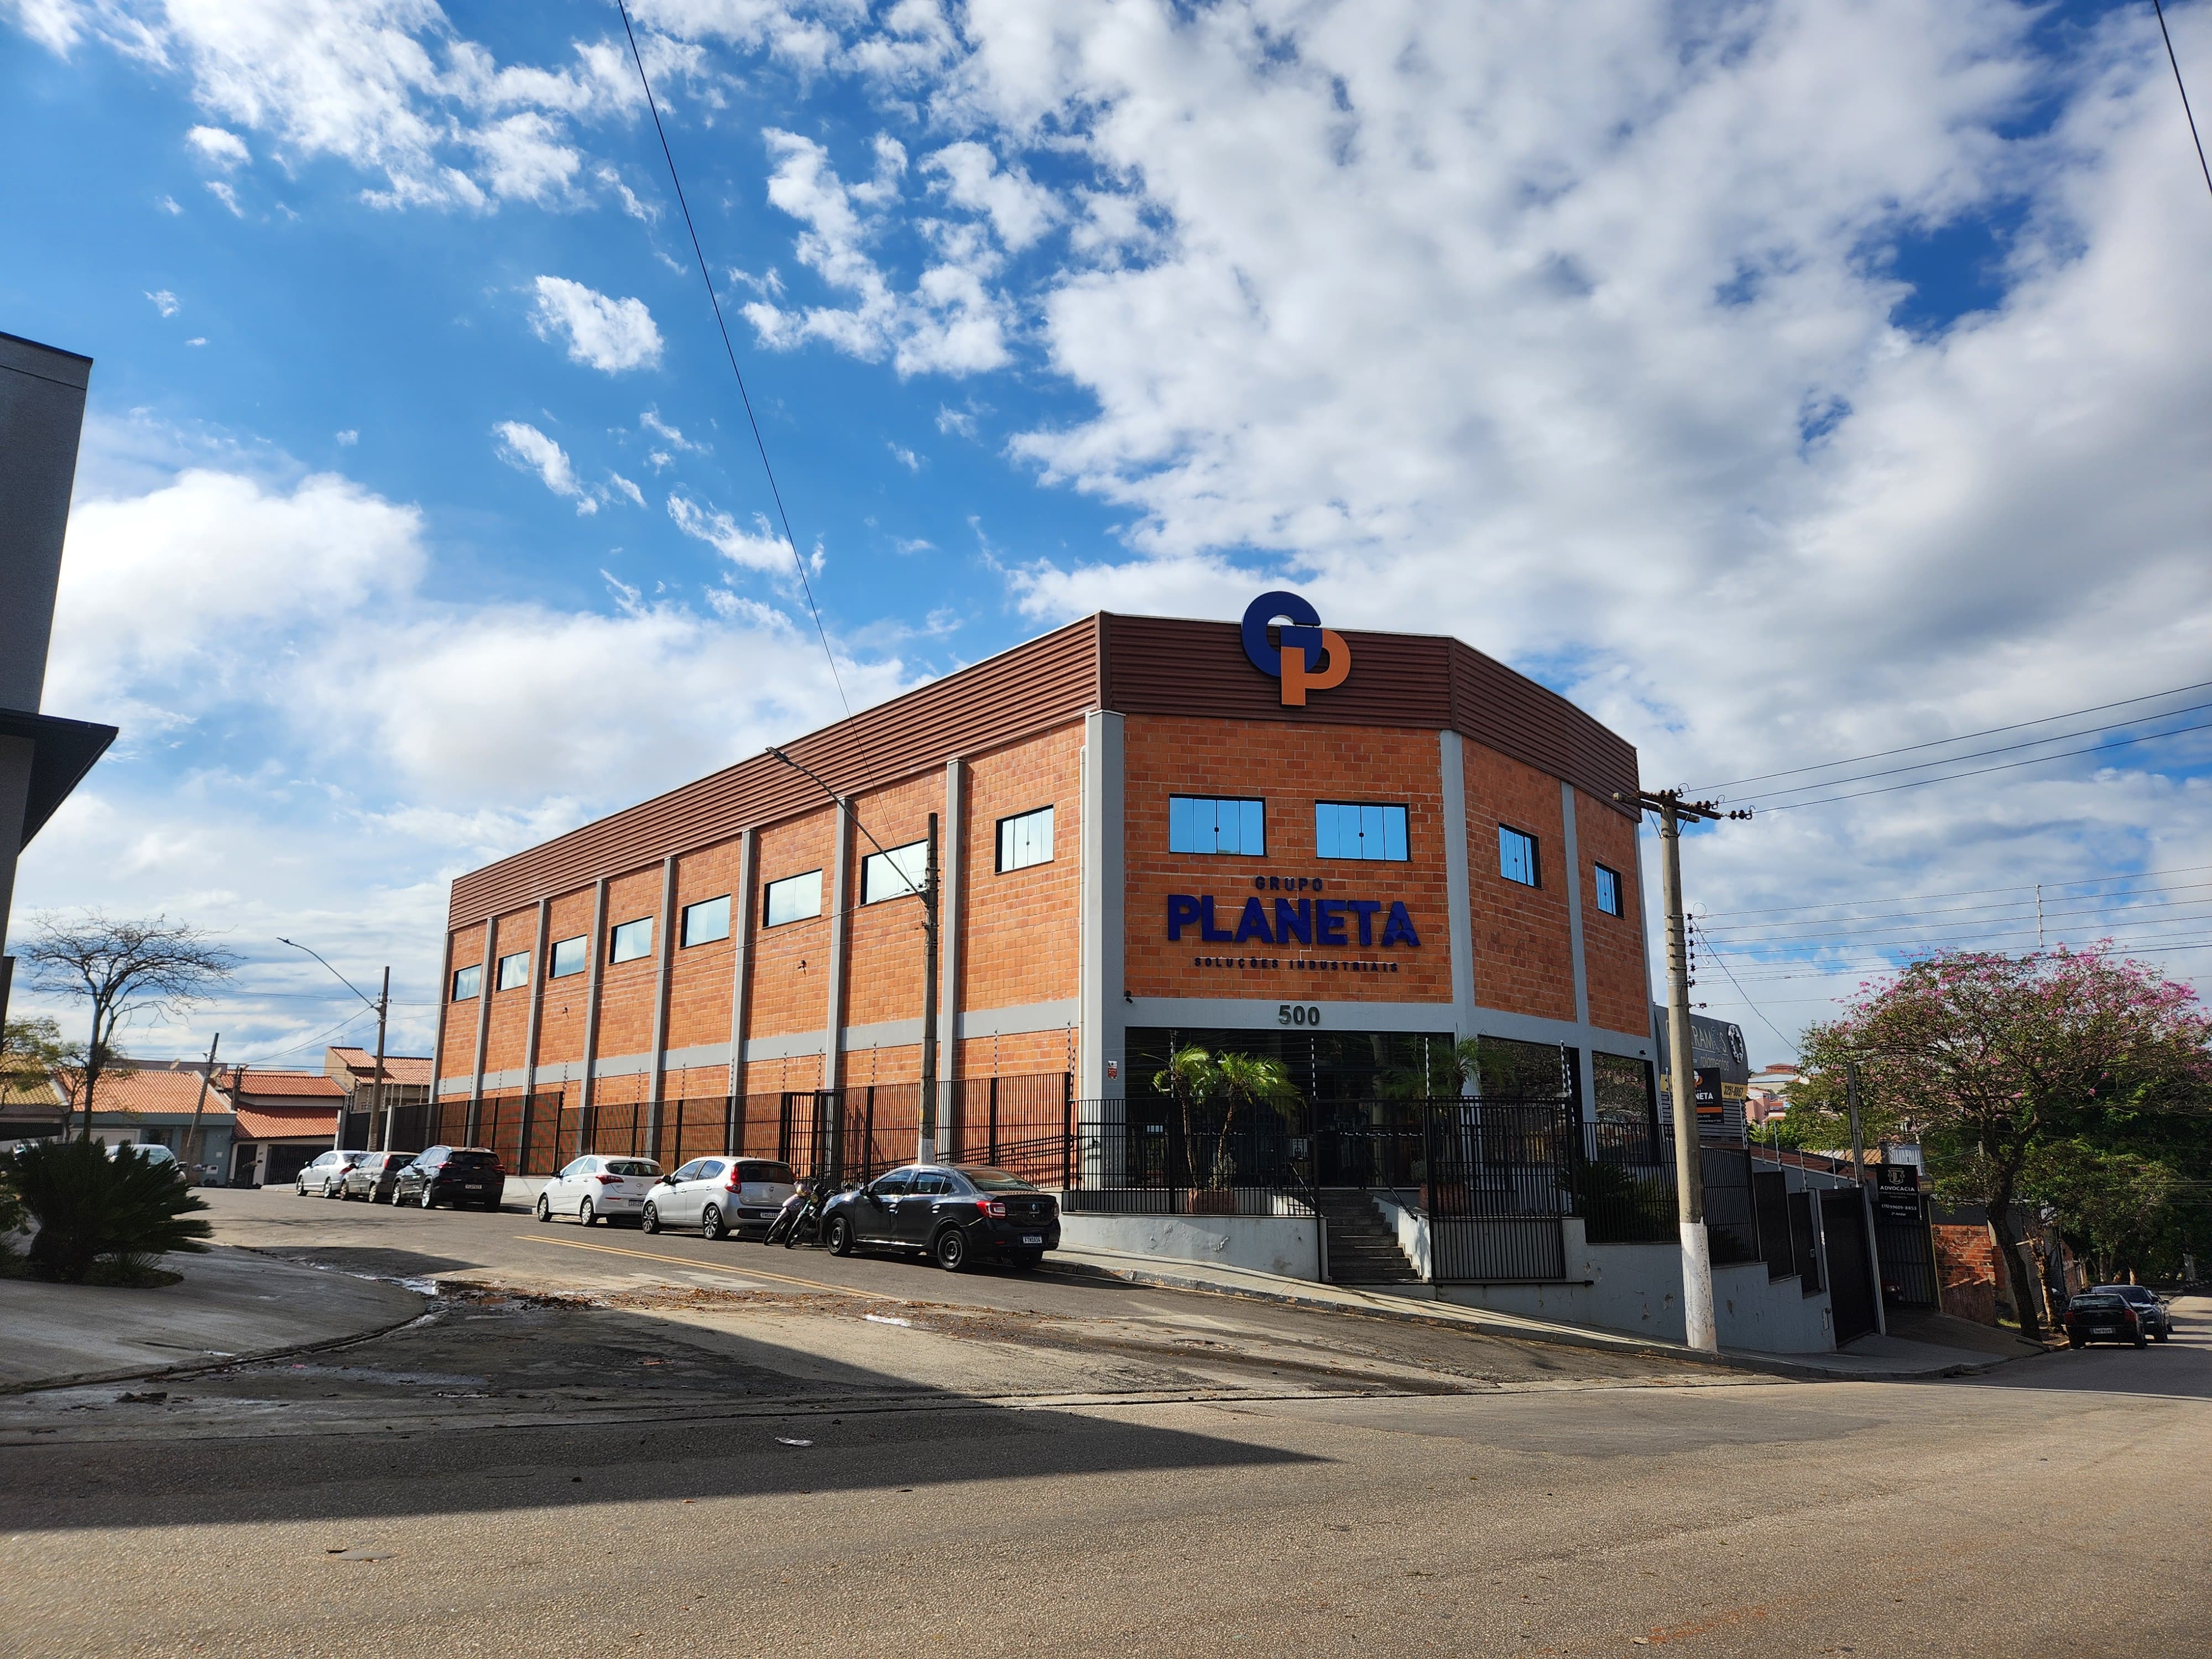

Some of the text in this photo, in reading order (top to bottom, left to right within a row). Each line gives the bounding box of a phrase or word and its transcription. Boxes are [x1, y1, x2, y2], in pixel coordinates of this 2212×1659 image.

[1255, 876, 1323, 891] GRUPO
[1167, 894, 1421, 947] PLANETA
[1194, 956, 1398, 972] SOLUÇÕES INDUSTRIAIS
[1278, 1004, 1321, 1026] 500
